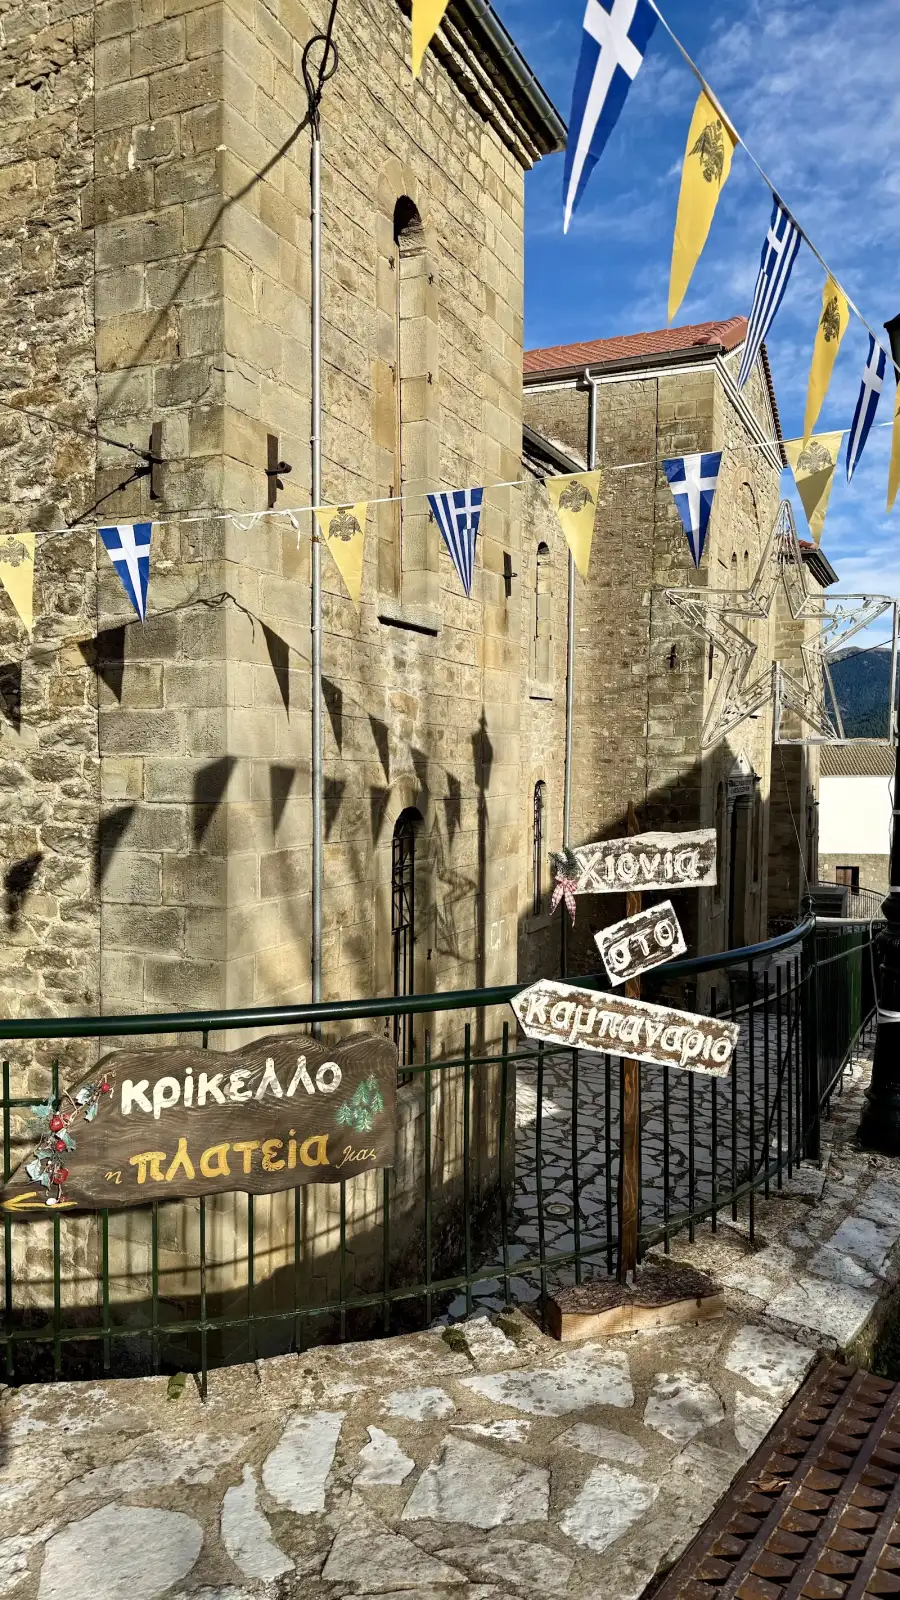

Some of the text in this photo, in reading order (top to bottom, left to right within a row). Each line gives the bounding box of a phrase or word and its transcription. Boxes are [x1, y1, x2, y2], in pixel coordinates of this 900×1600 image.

[608, 919, 675, 972] στο
[129, 1128, 330, 1184] πλατεία
[335, 1144, 377, 1169] μας
